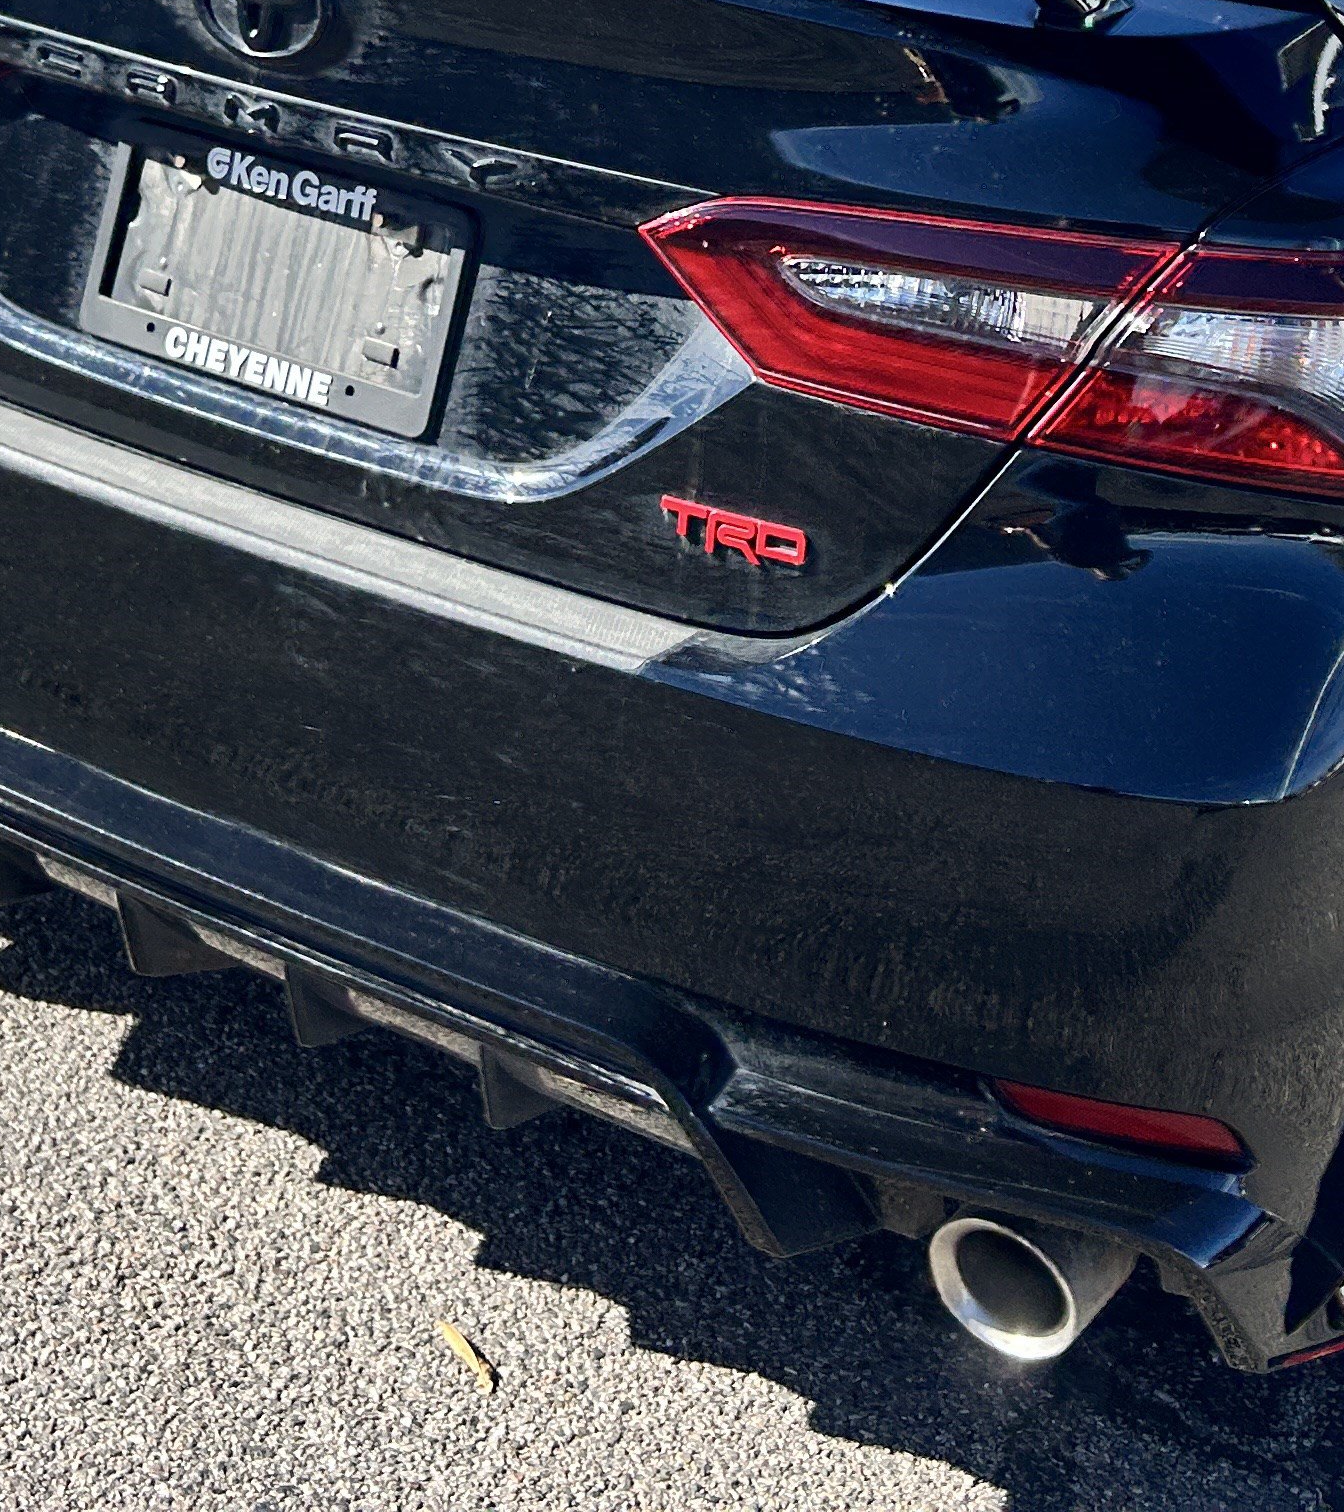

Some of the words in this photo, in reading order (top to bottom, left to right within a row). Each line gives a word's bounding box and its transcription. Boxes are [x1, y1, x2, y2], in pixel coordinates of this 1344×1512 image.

[35, 40, 519, 187] CAMRY
[231, 150, 287, 201] Ken
[291, 169, 377, 221] Garff
[164, 325, 335, 406] CHEYENNE
[660, 494, 806, 566] TRD
